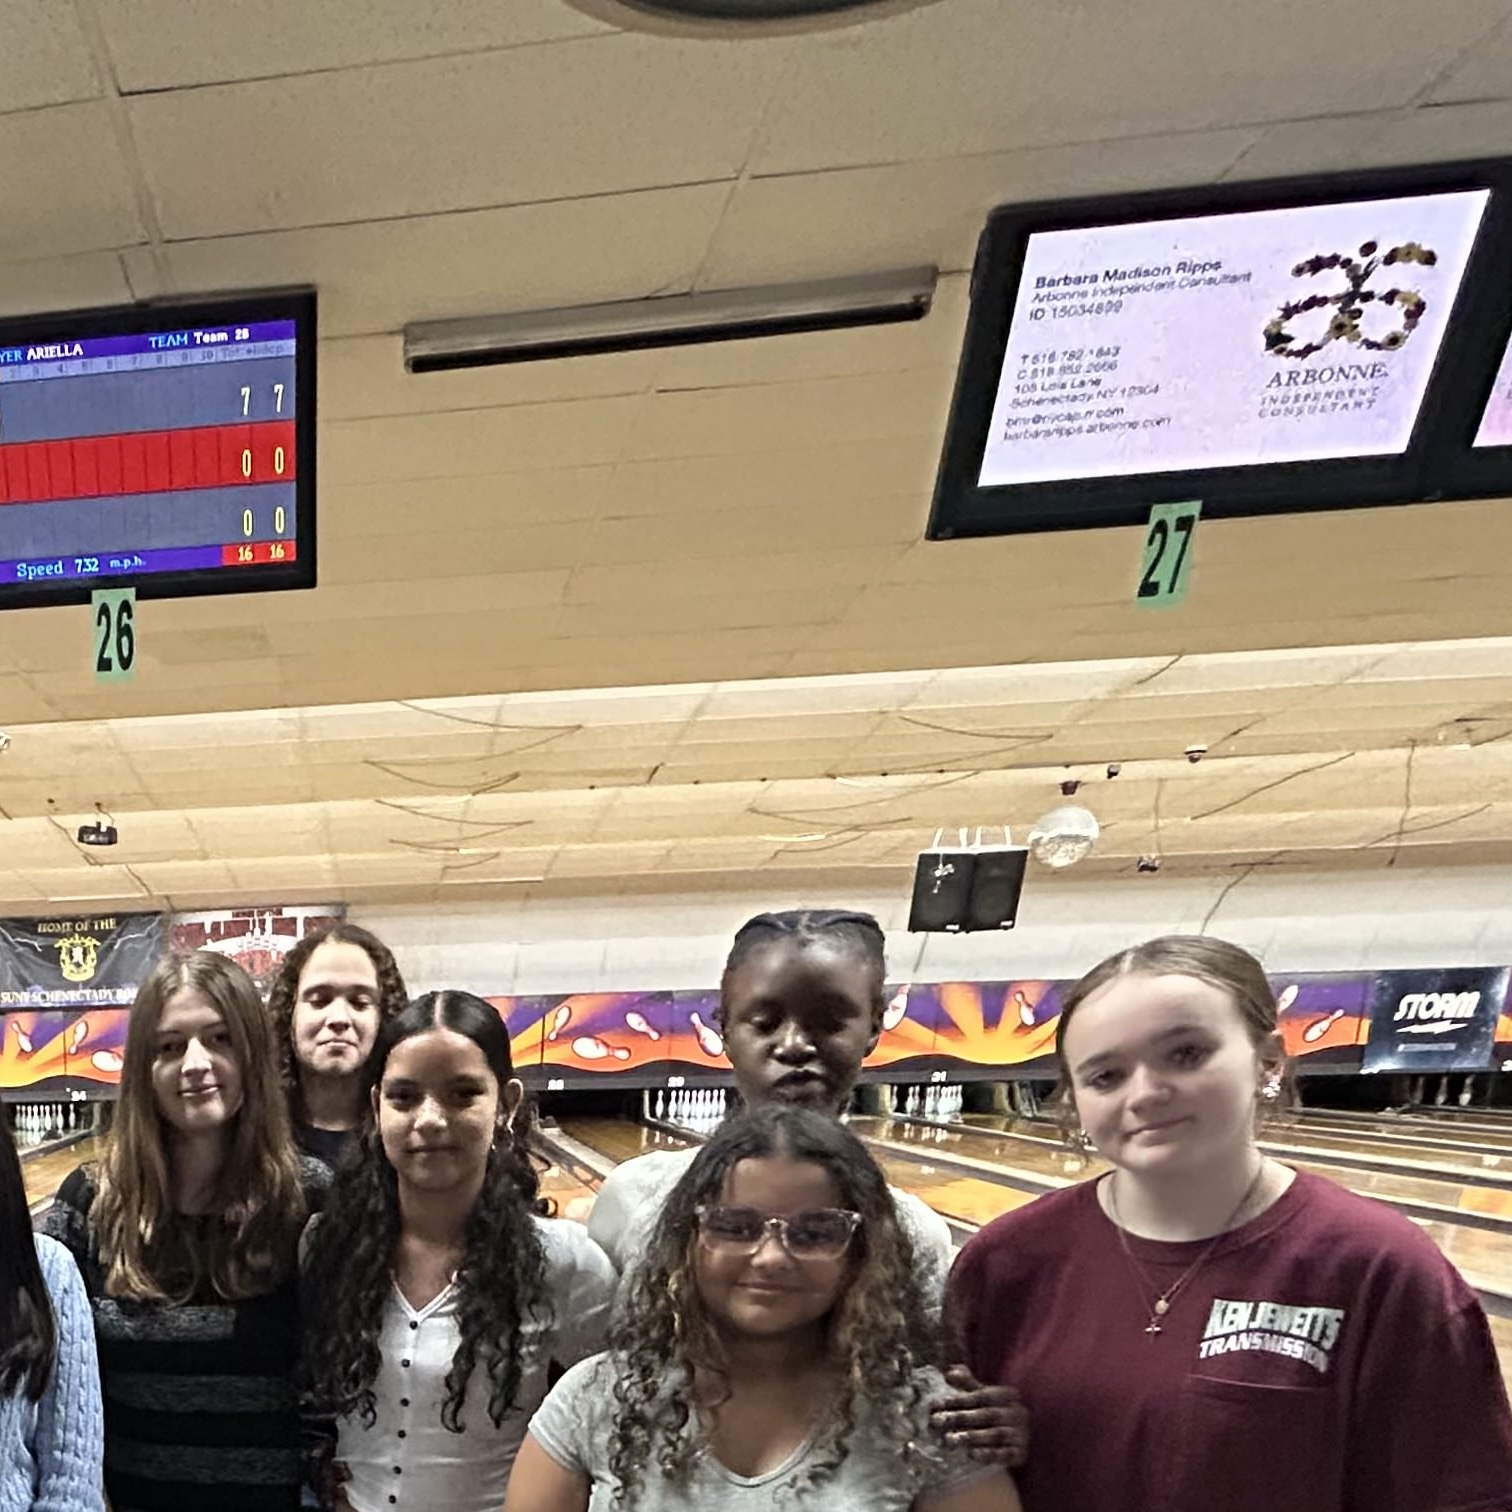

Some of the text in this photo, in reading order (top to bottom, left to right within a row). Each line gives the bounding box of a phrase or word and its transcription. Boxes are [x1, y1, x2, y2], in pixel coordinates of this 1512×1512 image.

[1035, 260, 1222, 289] Barbara Madison Ripps
[1030, 308, 1045, 321] ID
[27, 343, 83, 360] ARIELLA
[149, 333, 188, 348] TEAM
[194, 331, 228, 344] Team
[1266, 362, 1386, 388] ARBONNE
[241, 387, 250, 416] 7
[274, 384, 284, 413] 7
[241, 449, 252, 477] 0
[274, 446, 284, 474] 0
[242, 509, 253, 536] 0
[274, 506, 284, 534] 0
[17, 561, 63, 580] Speed
[238, 545, 253, 562] 16
[269, 542, 284, 558] 16
[1138, 514, 1196, 598] 27
[96, 600, 134, 672] 26
[38, 918, 117, 933] HOME OF THE
[1393, 991, 1481, 1021] STORM
